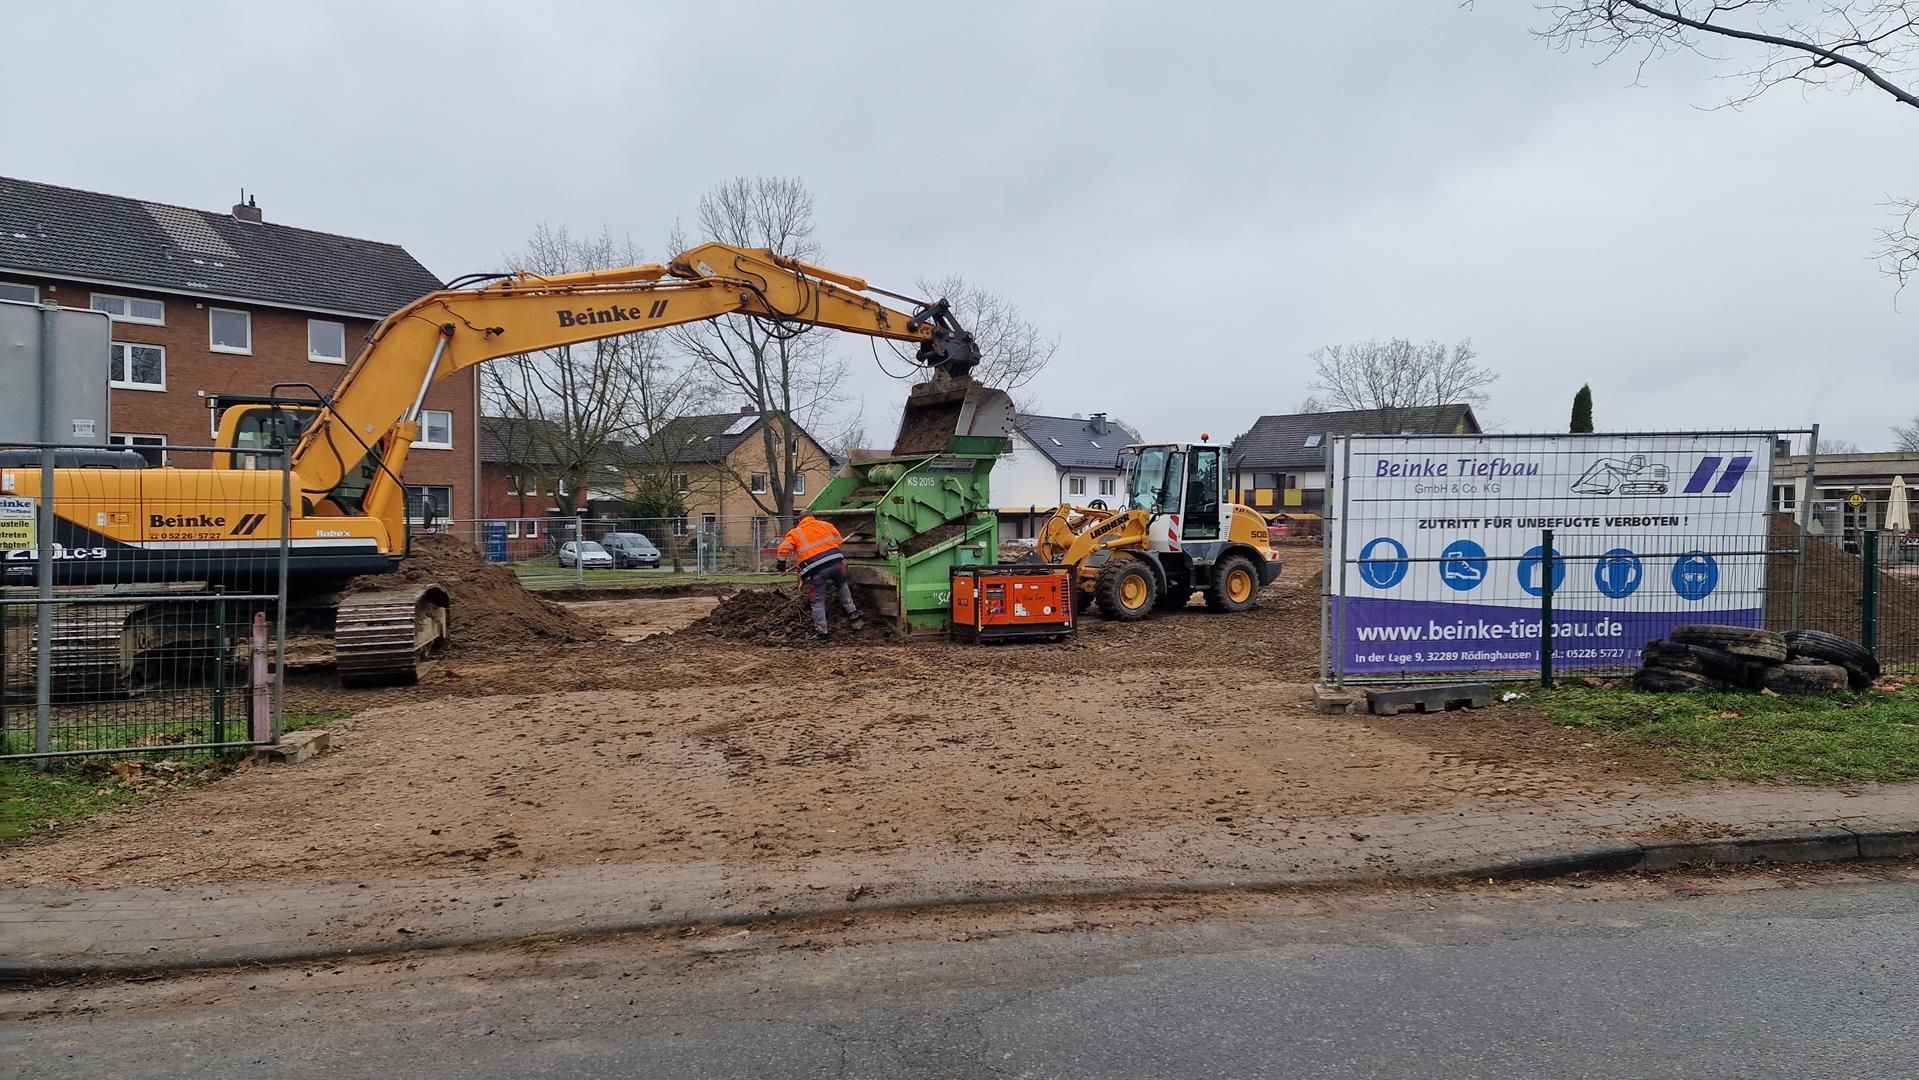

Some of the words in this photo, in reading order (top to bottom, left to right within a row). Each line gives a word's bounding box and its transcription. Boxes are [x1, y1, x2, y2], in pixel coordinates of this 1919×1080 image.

[556, 305, 641, 328] Beinke
[1376, 458, 1448, 477] Beinke
[1457, 458, 1539, 480] Tiefbau
[907, 477, 918, 486] KS
[919, 477, 935, 486] 2015
[1415, 484, 1448, 493] GmbH
[1451, 484, 1459, 493] &
[1462, 484, 1480, 493] Co.
[1484, 484, 1500, 493] KG
[150, 514, 225, 528] Beinke
[1090, 513, 1130, 539] LIEBHERR
[1419, 519, 1480, 529] ZUTRITT
[1484, 516, 1512, 529] FÜR
[1517, 517, 1600, 528] UNBEFUGTE
[1605, 516, 1679, 527] VERBOTEN
[1251, 531, 1267, 539] 508
[1355, 654, 1366, 663] In
[1368, 653, 1385, 662] der
[1388, 653, 1412, 664] Lage
[1415, 652, 1424, 662] 9,
[1427, 652, 1458, 661] 32289
[1461, 650, 1531, 662] Rödinghausen
[1566, 649, 1597, 658] 05226
[1600, 649, 1624, 657] 5727
